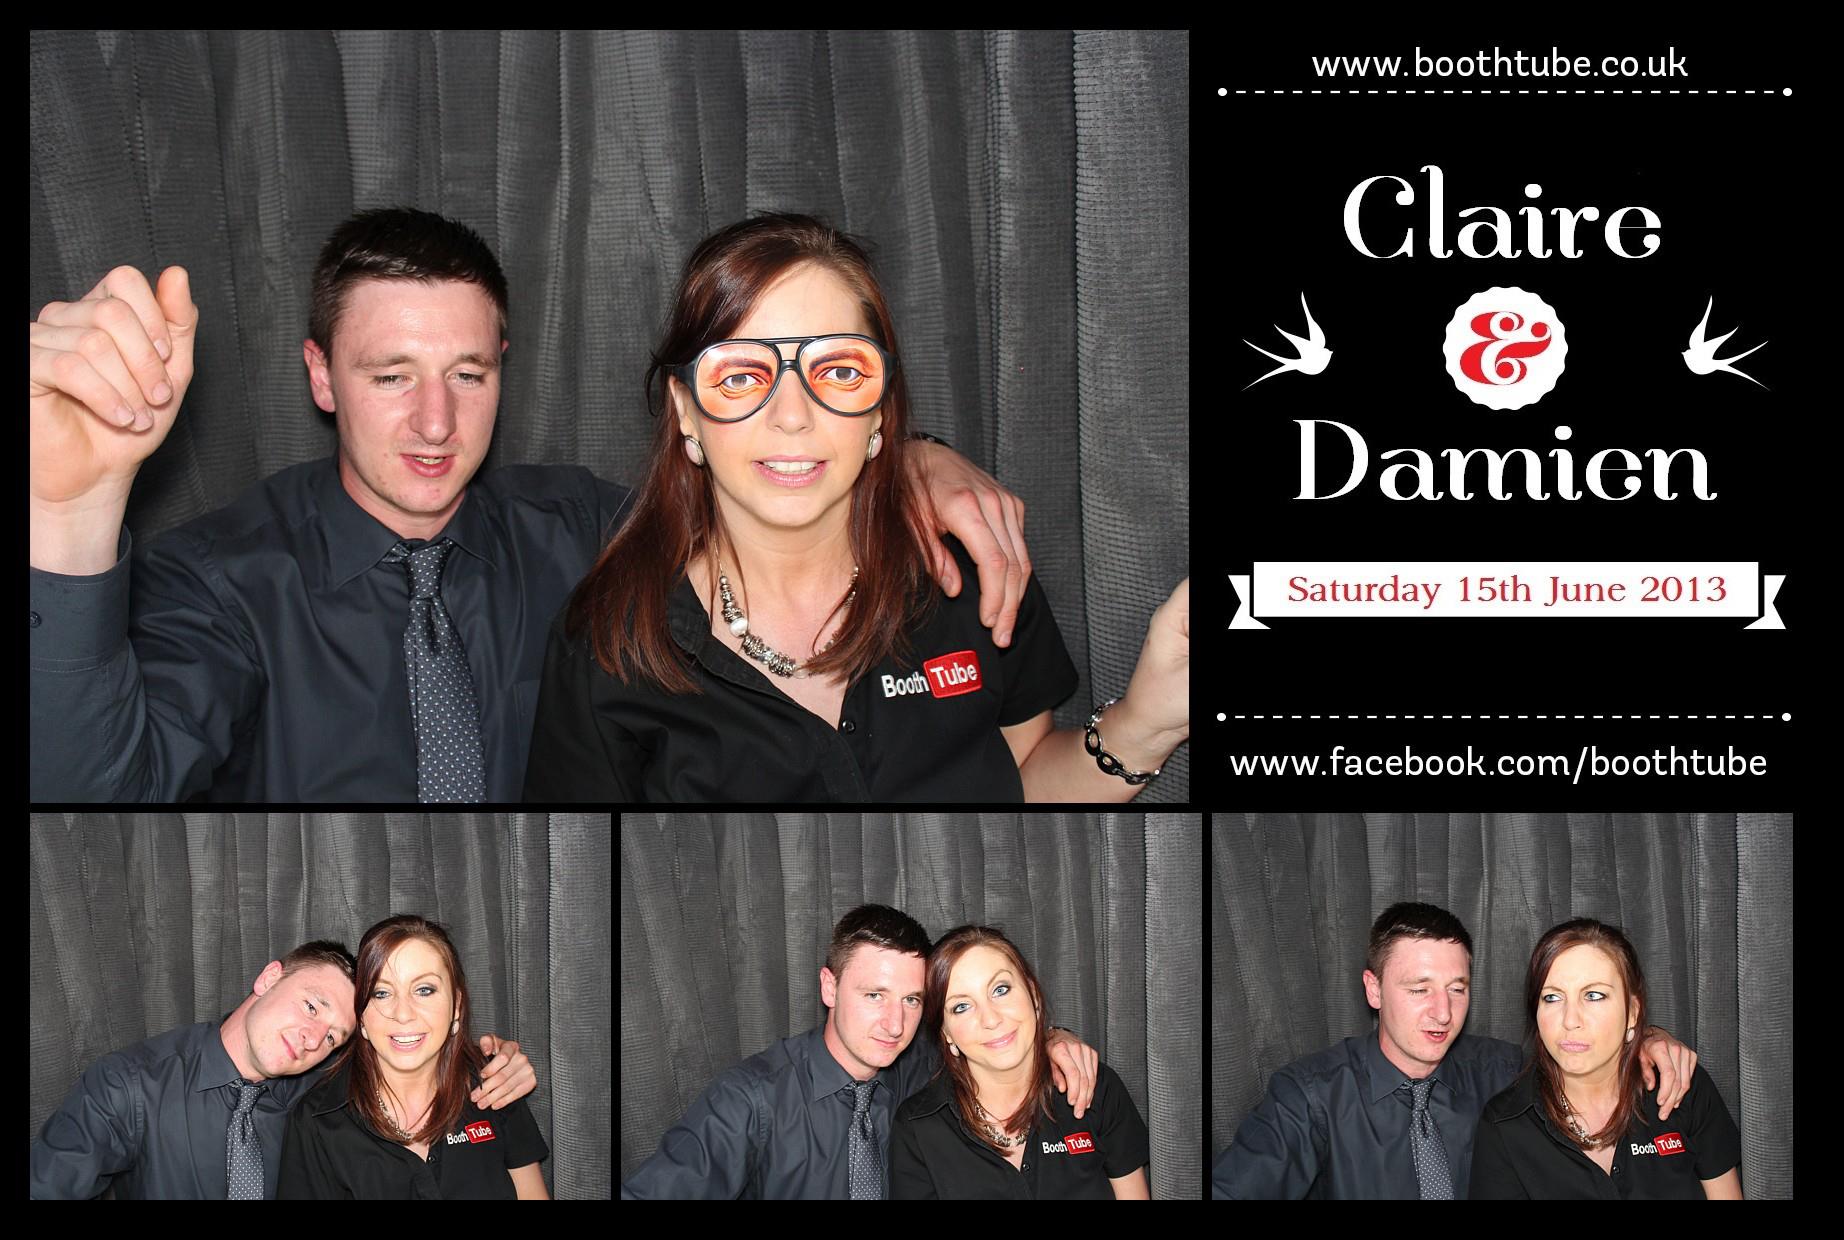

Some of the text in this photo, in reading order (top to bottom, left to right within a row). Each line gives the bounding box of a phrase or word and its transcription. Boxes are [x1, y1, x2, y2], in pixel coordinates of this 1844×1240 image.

[881, 662, 978, 698] Booth Tube
[446, 1125, 492, 1145] Booth Tube
[1042, 1136, 1092, 1154] Booth Tube
[1630, 1137, 1682, 1156] Booth Tube
